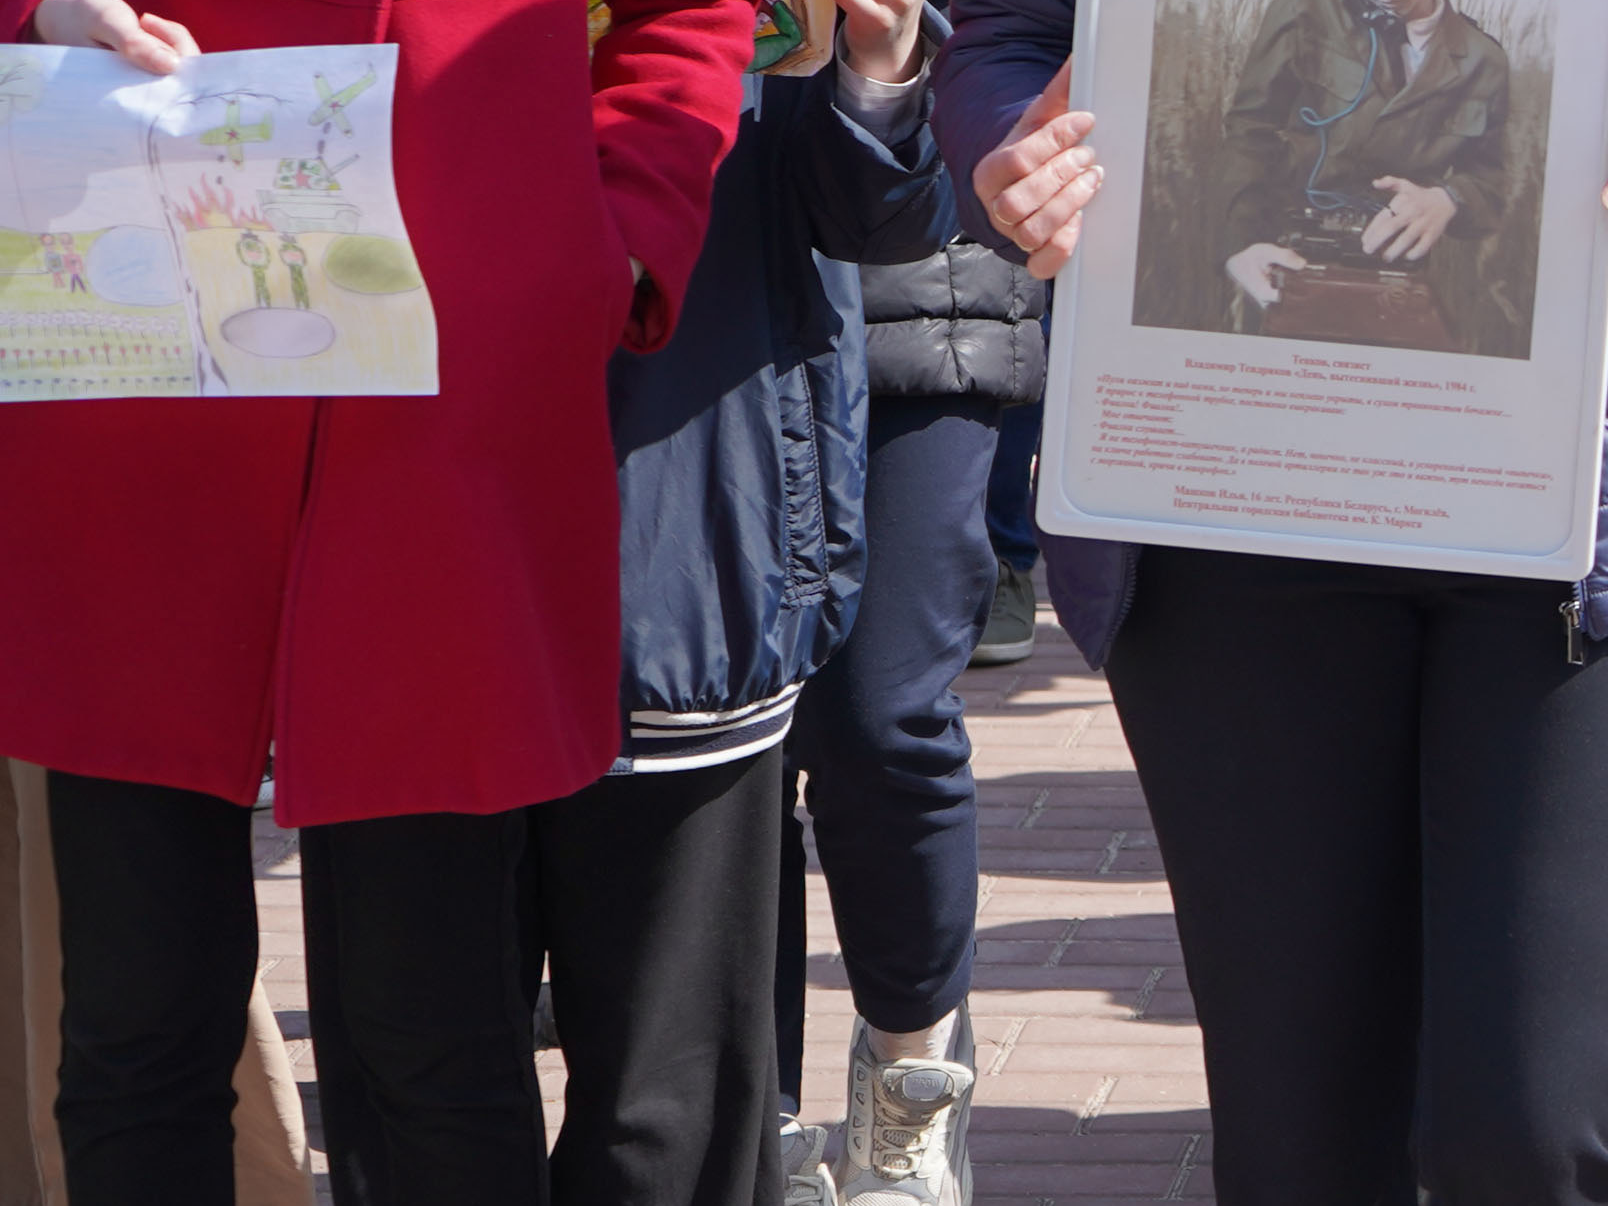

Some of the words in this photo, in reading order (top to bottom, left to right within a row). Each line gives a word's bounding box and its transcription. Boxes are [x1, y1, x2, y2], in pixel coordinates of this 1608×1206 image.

[1446, 381, 1467, 392] 1984
[1285, 494, 1341, 509] Республика
[1173, 498, 1238, 512] Центральная
[1293, 508, 1348, 522] библиотека
